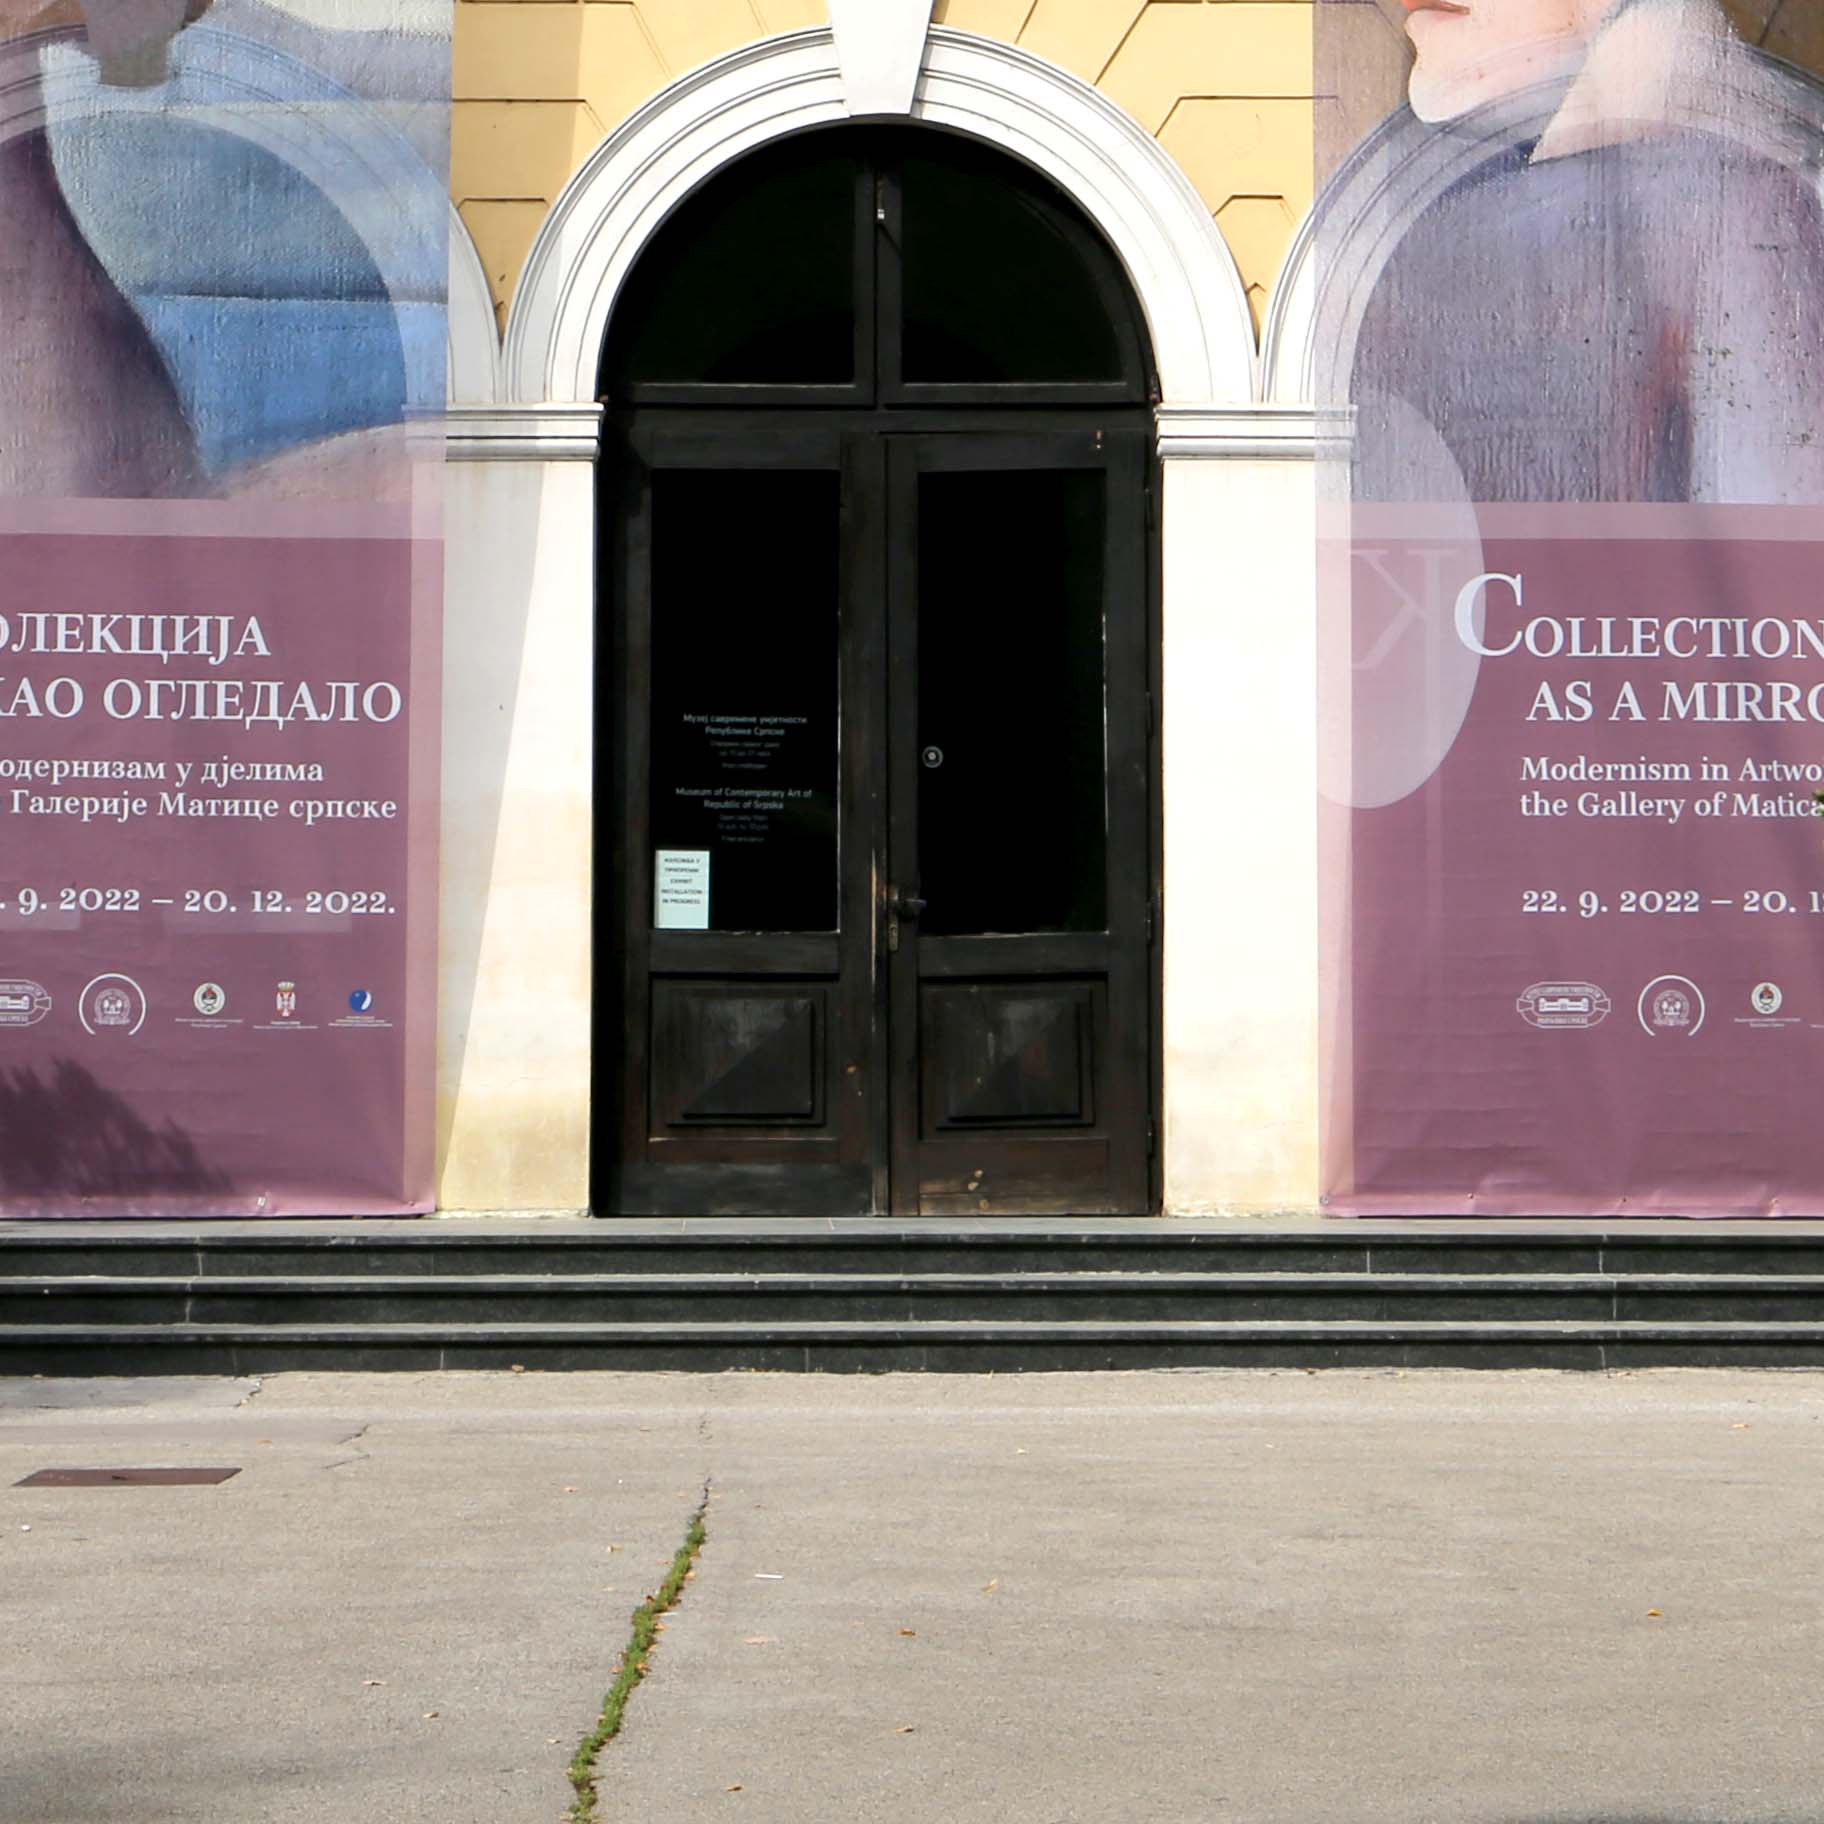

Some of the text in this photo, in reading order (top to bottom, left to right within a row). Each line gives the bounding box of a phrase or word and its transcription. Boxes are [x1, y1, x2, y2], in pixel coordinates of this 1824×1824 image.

[103, 677, 402, 731] ОГЛЕДАЛО
[1524, 680, 1594, 722] AS
[1607, 680, 1647, 722] A
[174, 761, 194, 788] у
[200, 753, 325, 787] дјелима
[1519, 755, 1692, 783] Modernism
[1700, 755, 1731, 783] in
[9, 787, 149, 824] Галерије
[156, 790, 281, 820] Матице
[288, 797, 398, 826] српске
[1519, 790, 1569, 817] the
[1577, 789, 1686, 825] Gallery
[1693, 789, 1726, 817] of
[17, 887, 48, 916] 9.
[58, 887, 141, 912] 2022
[183, 889, 237, 913] 20.
[251, 890, 293, 913] 12.
[305, 890, 396, 914] 2022.
[1522, 890, 1567, 913] 22.
[1578, 890, 1609, 919] 9.
[1619, 890, 1700, 914] 2022
[1743, 890, 1797, 914] 20.
